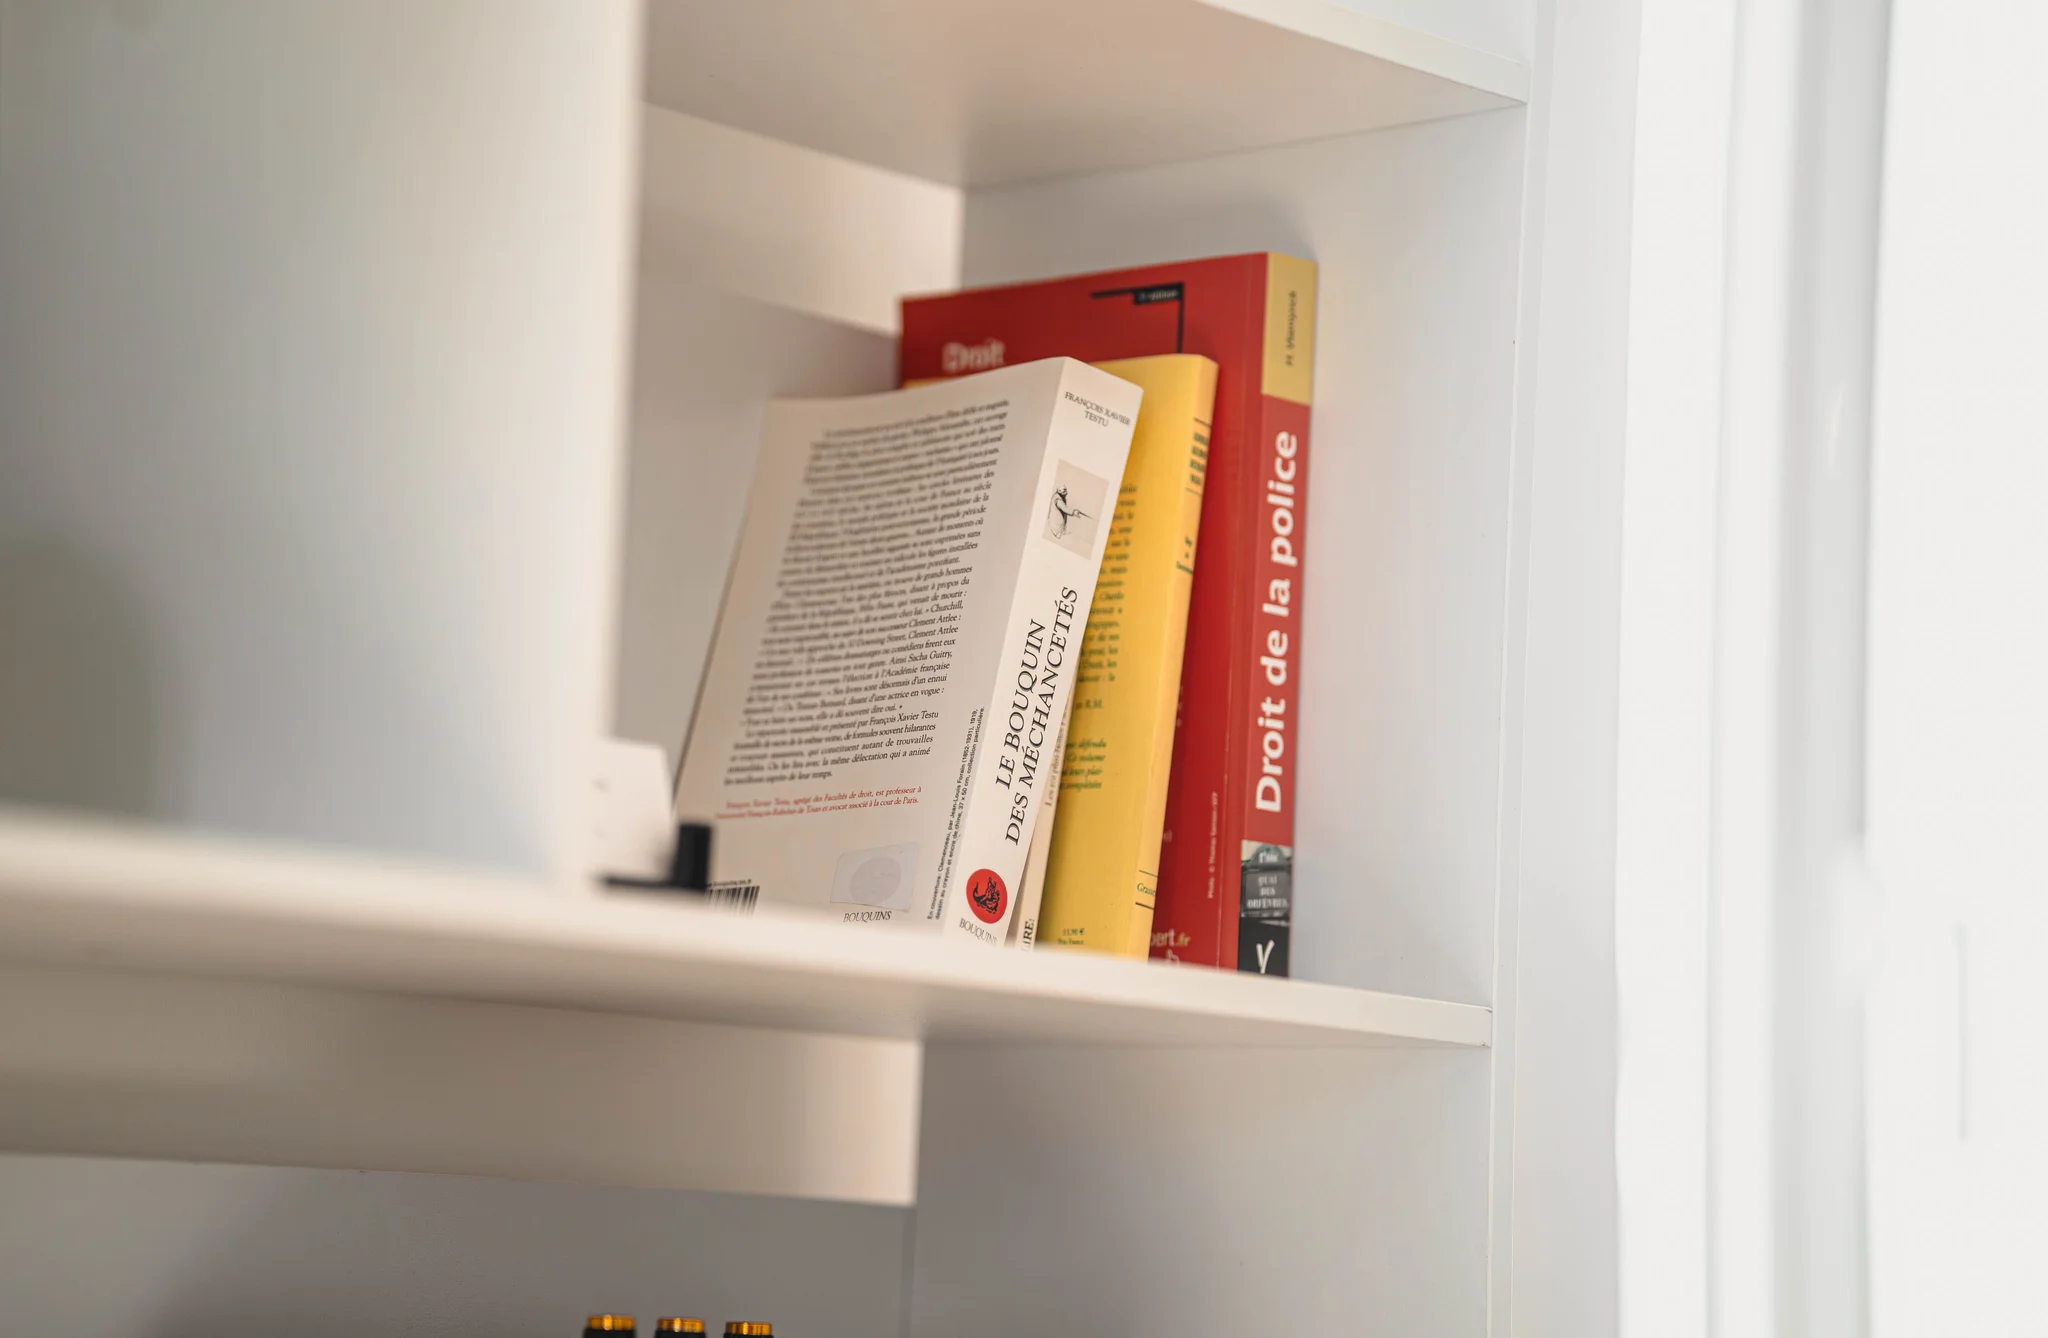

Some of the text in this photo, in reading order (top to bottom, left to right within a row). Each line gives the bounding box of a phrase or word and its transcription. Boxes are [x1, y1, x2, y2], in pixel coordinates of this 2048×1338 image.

[1065, 391, 1131, 426] FRANÇOIS XAVIER
[1084, 410, 1109, 427] TESTU
[982, 493, 989, 501] la
[945, 517, 983, 530] moments où
[934, 533, 966, 544] exprimées
[948, 541, 978, 552] installées
[926, 556, 959, 568] pontifiant.
[914, 572, 923, 582] de
[945, 566, 972, 576] hommes
[936, 580, 959, 590] propos
[960, 576, 970, 585] du
[909, 590, 963, 604] venait de mourir
[930, 600, 963, 612] Churchill,
[908, 613, 957, 628] Clement Attlee
[1255, 431, 1298, 812] Droit de la police
[937, 625, 958, 635] Attlee
[925, 639, 942, 648] firent
[888, 656, 907, 665] Ainsi
[908, 652, 928, 662] Sacha
[929, 650, 952, 659] Guitry,
[881, 666, 918, 677] l'Académie
[920, 662, 950, 672] française
[878, 679, 910, 689] désormais
[911, 676, 926, 685] d'un
[927, 673, 947, 683] ennui
[868, 693, 886, 702] d'une
[887, 691, 909, 700] actrice
[920, 688, 940, 696] vogue
[844, 703, 896, 717] souvent dire oui.
[995, 618, 1047, 790] LE BOUQUIN
[856, 720, 868, 729] par
[869, 715, 896, 725] François
[897, 712, 919, 722] Xavier
[920, 710, 938, 719] Testu
[1005, 792, 1030, 846] DES
[1018, 586, 1079, 790] MÉCHANCETÉS
[843, 731, 852, 740] de
[879, 727, 903, 736] souvent
[904, 724, 935, 732] hilarantes
[973, 707, 984, 742] particulière.
[821, 734, 933, 754] constituent autant de trouvailles
[851, 752, 887, 762] délectation
[889, 749, 901, 760] qui
[908, 746, 930, 756] animé
[967, 743, 976, 773] collection
[823, 793, 847, 801] Facultés
[848, 791, 856, 799] de
[857, 790, 873, 798] droit,
[885, 787, 915, 797] professeur
[873, 798, 879, 807] la
[893, 796, 902, 805] de
[902, 796, 918, 804] Paris.
[957, 801, 964, 809] 37
[927, 910, 933, 919] En
[930, 875, 941, 909] couverture
[938, 832, 951, 871] Clemenceau,
[950, 784, 961, 818] Jean-Louis
[956, 764, 965, 783] Forain
[962, 726, 974, 762] (1852-1931),
[970, 709, 978, 724] 1919,
[954, 811, 962, 829] chine,
[952, 830, 958, 839] de
[940, 889, 945, 897] au
[843, 910, 892, 923] BOUQUINS
[935, 899, 943, 919] dessin
